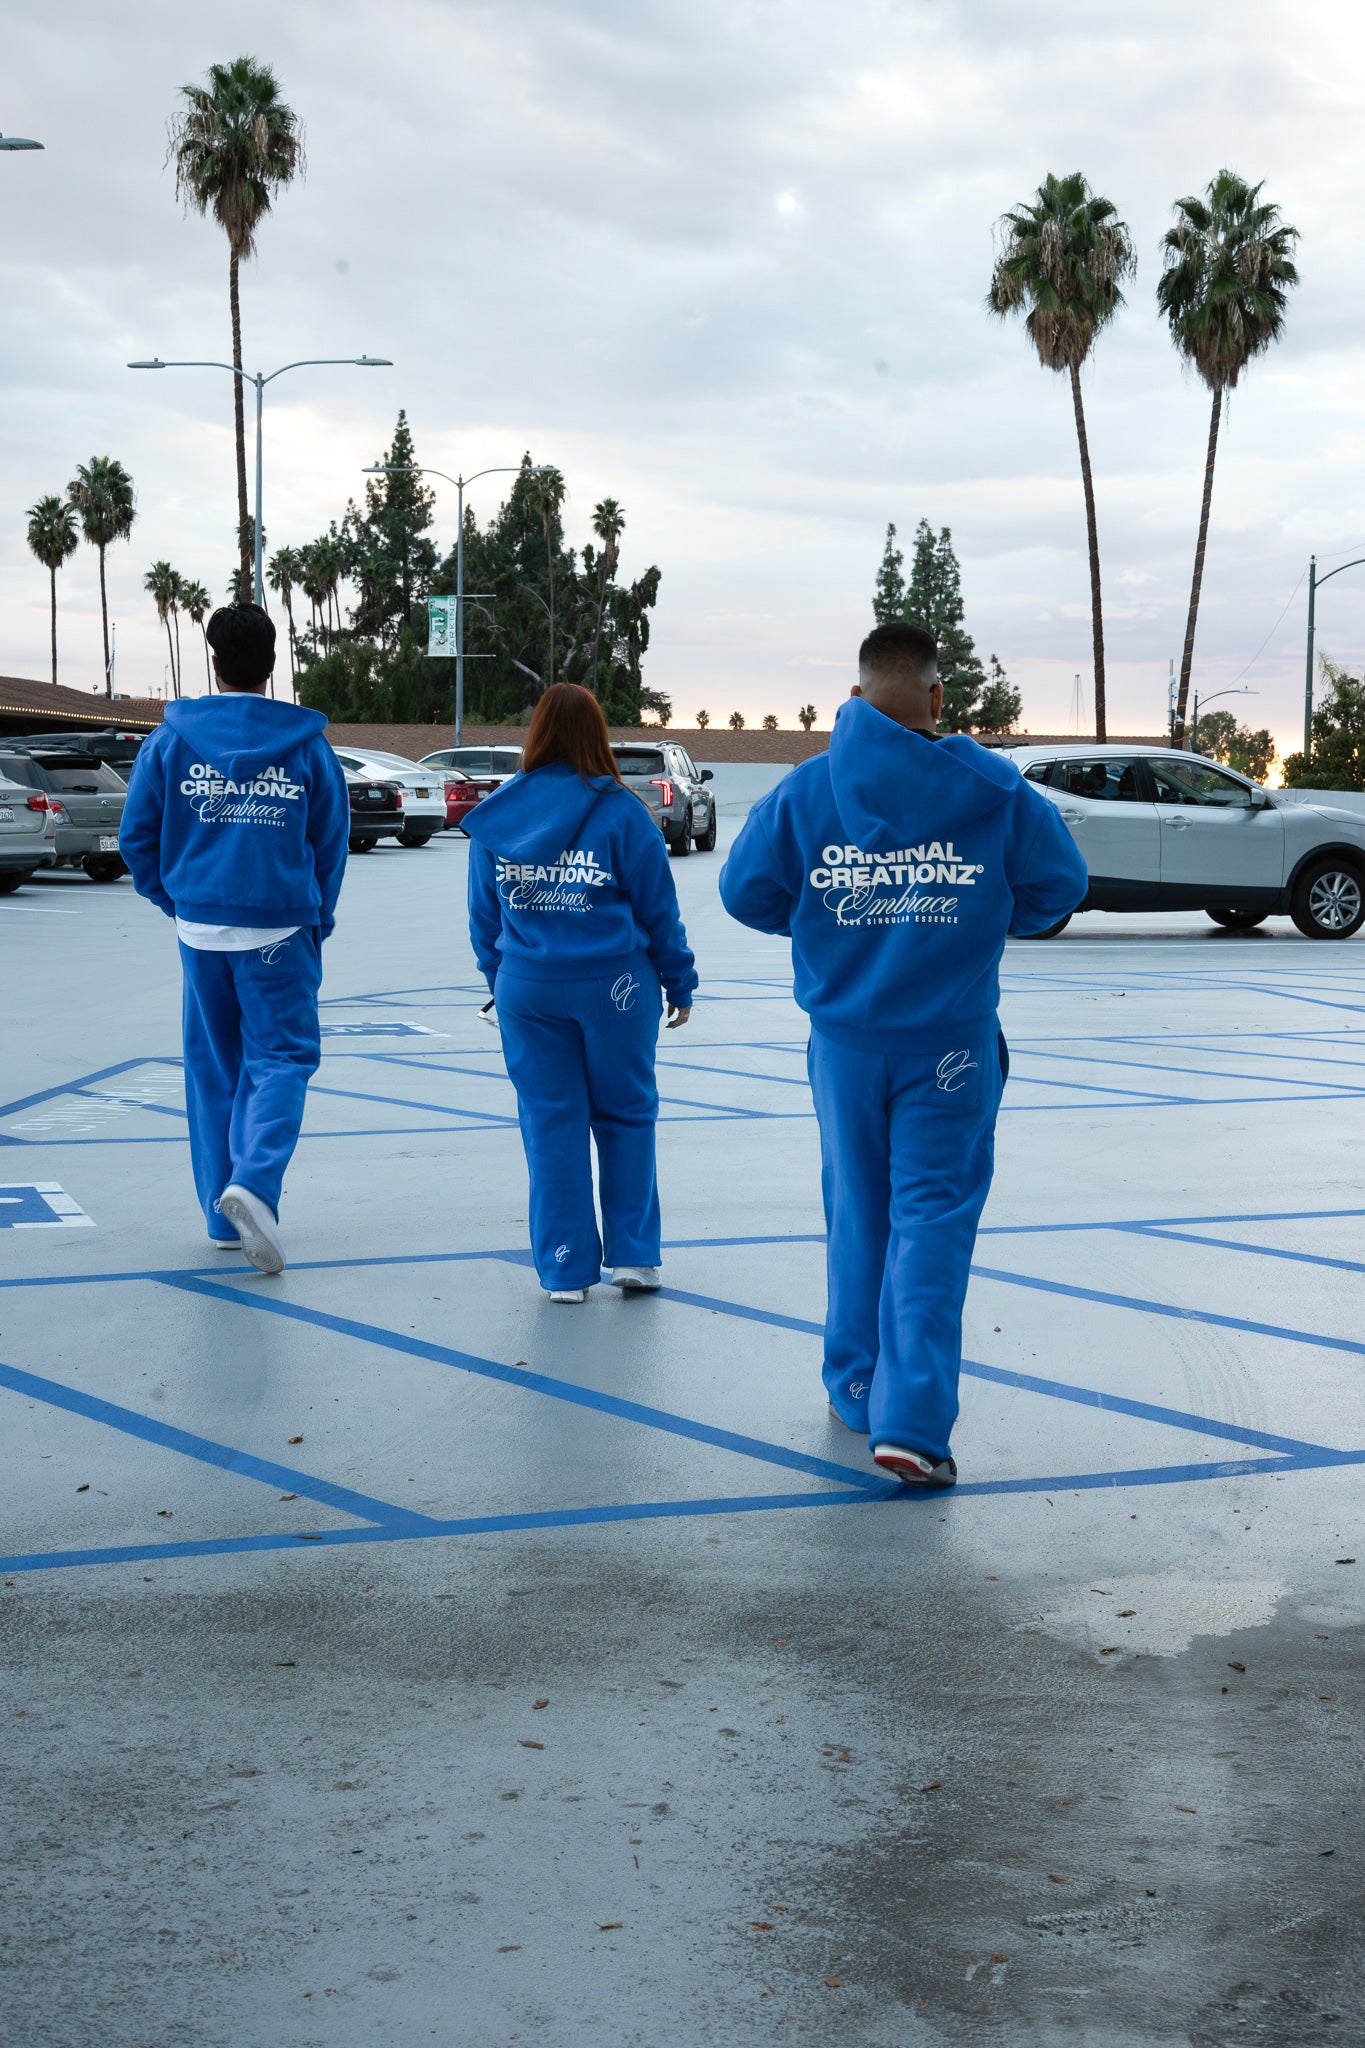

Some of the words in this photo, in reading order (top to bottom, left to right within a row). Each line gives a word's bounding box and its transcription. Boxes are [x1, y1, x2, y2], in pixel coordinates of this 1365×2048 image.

[449, 597, 457, 655] PARKING
[189, 785, 287, 821] Embrace
[822, 871, 958, 922] Embrace
[836, 918, 861, 926] YOUR
[866, 915, 910, 926] SINGULAR
[915, 916, 958, 925] ESSENCE
[9, 1086, 181, 1132] PARKING
